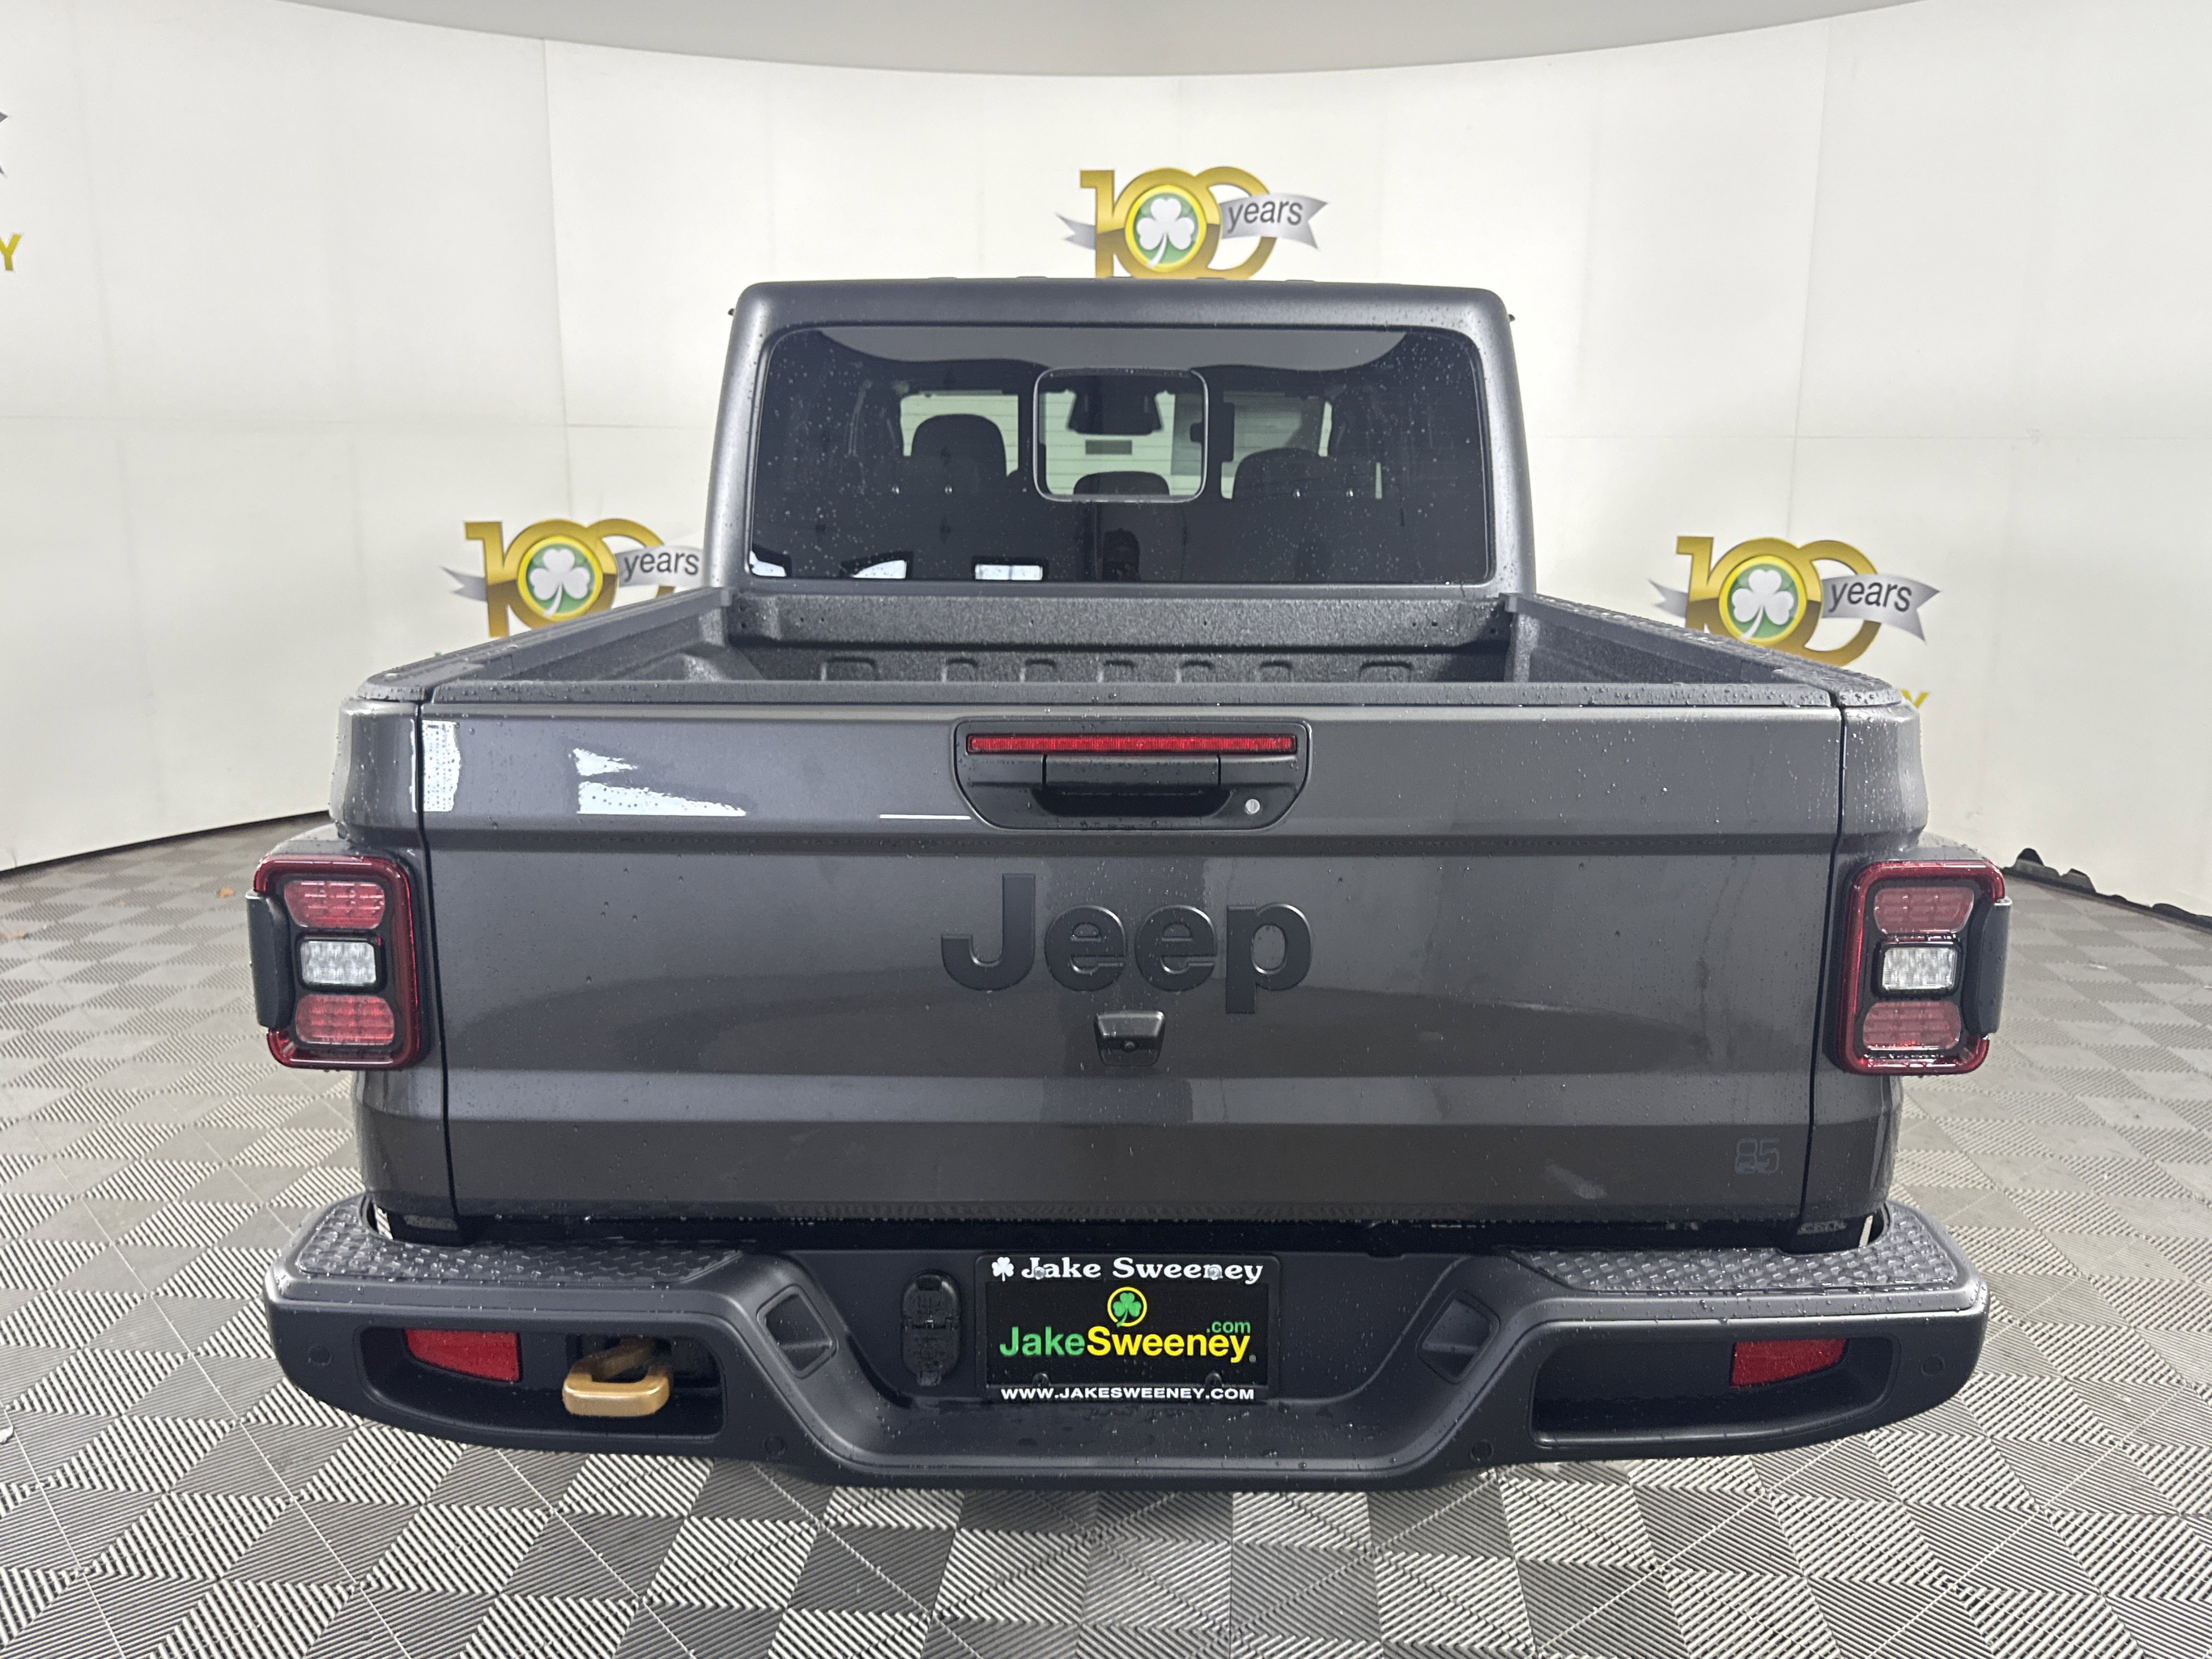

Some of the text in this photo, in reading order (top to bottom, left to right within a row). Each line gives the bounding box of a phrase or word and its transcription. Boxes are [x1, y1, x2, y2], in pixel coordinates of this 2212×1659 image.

[1080, 167, 1304, 279] 100 years
[624, 551, 700, 582] years
[1676, 536, 1912, 667] 100 years
[940, 873, 1312, 1014] Jeep
[1021, 1256, 1263, 1285] Jake Sweeney
[1000, 1387, 1255, 1400] WWW.JAKESWEENEY.COM
